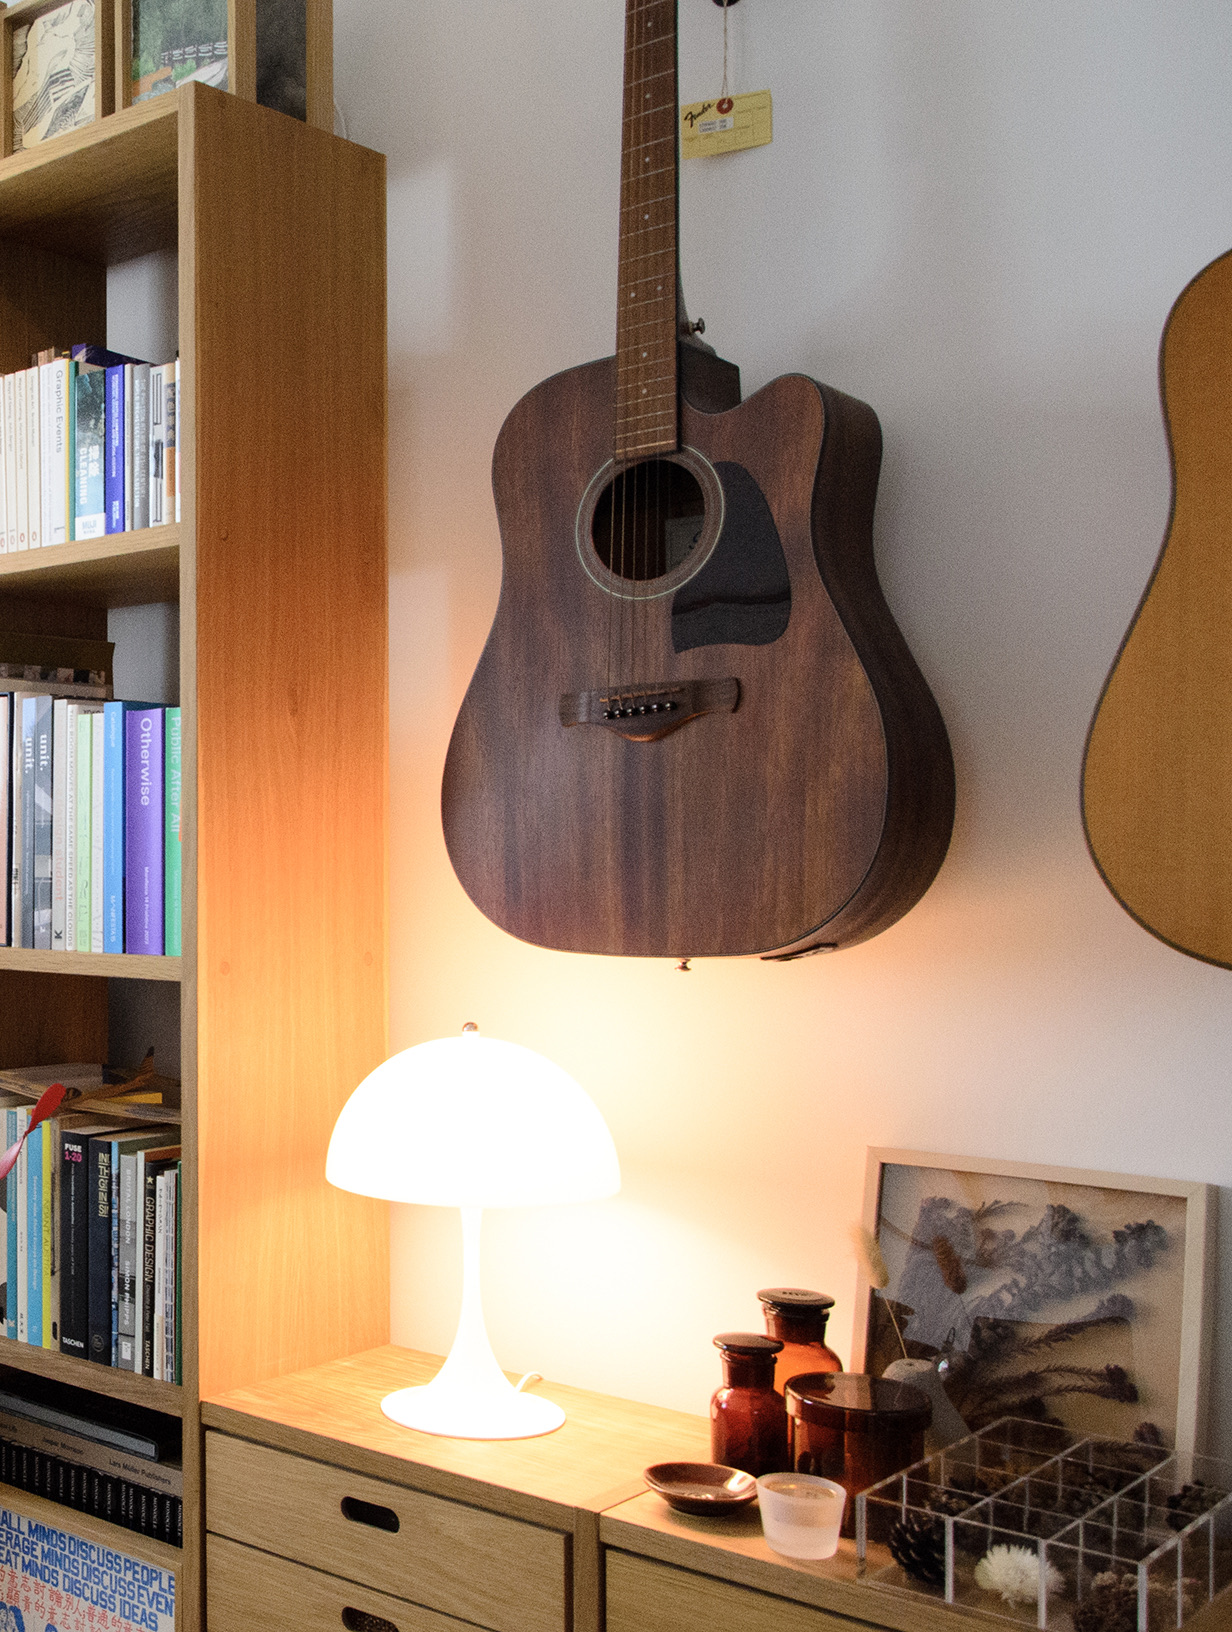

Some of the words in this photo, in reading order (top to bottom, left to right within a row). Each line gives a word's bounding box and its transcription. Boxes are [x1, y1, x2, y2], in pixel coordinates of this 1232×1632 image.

[684, 102, 716, 128] Fender
[54, 370, 64, 413] Graphic
[55, 416, 64, 453] Events
[78, 448, 88, 504] CLEANING
[81, 520, 97, 530] MUJI
[109, 711, 117, 748] Catalogue
[170, 717, 182, 764] Public
[24, 737, 34, 774] unit.
[39, 734, 48, 772] unit.
[140, 718, 152, 806] Otherwise
[68, 795, 75, 806] AT
[170, 769, 182, 808] After
[52, 803, 65, 846] design
[170, 812, 182, 833] All
[53, 848, 65, 901] student
[68, 880, 74, 891] AS
[64, 1142, 83, 1152] FUSE
[64, 1151, 83, 1162] 1-20
[144, 1197, 155, 1241] GRAPHIC
[144, 1243, 154, 1282] DESIGN
[62, 1337, 84, 1348] TASCHEN
[42, 1437, 58, 1449] Jasper
[60, 1441, 84, 1456] Morrison
[109, 1458, 122, 1469] Lars
[123, 1462, 140, 1475] Müller
[141, 1466, 172, 1486] Publishers
[28, 1520, 66, 1552] MINDS
[68, 1533, 122, 1574] DISCUSS
[124, 1558, 176, 1597] PEOPLE
[41, 1545, 79, 1580] MINDS
[81, 1563, 135, 1602] DISCUSS
[22, 1556, 59, 1588] MINDS
[63, 1574, 116, 1613] DISCUSS
[119, 1598, 158, 1632] IDEAS
